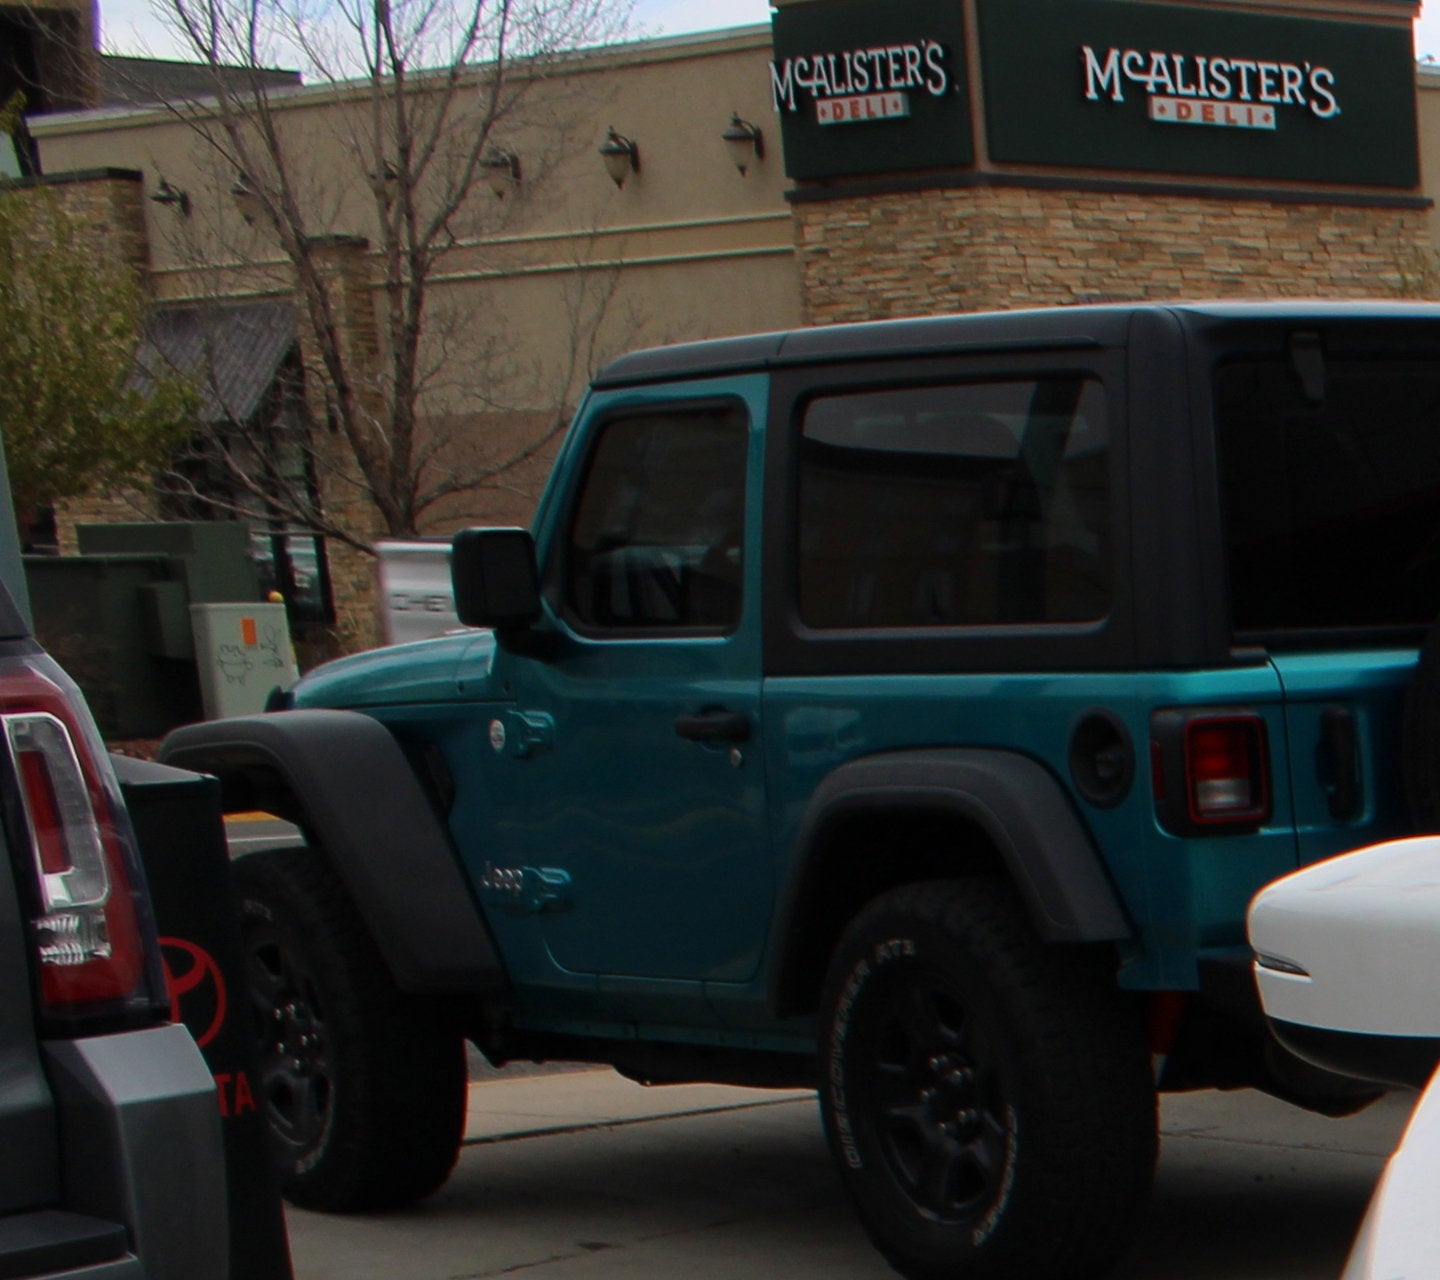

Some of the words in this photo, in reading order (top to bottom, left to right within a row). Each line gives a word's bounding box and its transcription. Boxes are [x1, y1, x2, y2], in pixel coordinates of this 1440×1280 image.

[831, 96, 888, 121] DELI
[1174, 102, 1254, 125] DELI
[481, 860, 526, 897] Jeep
